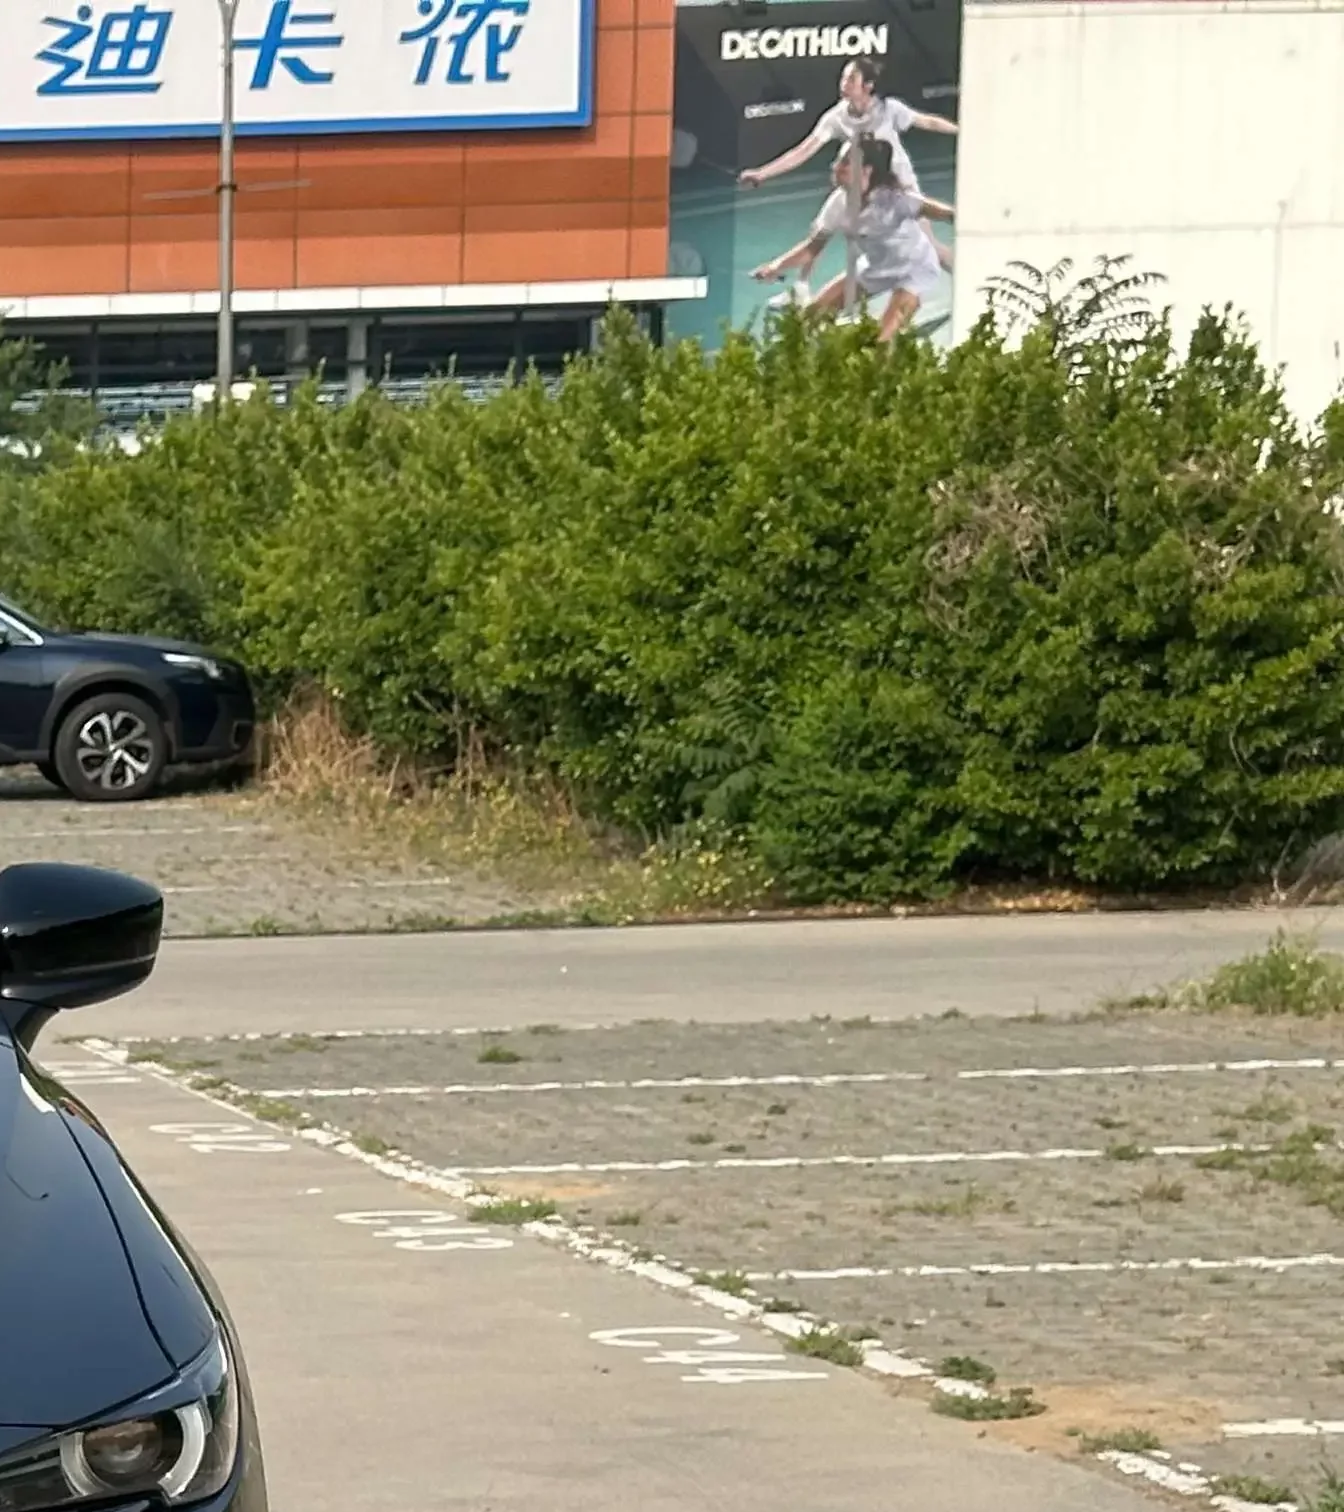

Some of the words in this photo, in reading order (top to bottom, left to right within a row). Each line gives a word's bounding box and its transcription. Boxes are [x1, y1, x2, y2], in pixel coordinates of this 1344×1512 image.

[720, 24, 889, 60] DECATHLON
[333, 1210, 514, 1251] C43
[588, 1326, 830, 1383] C44
